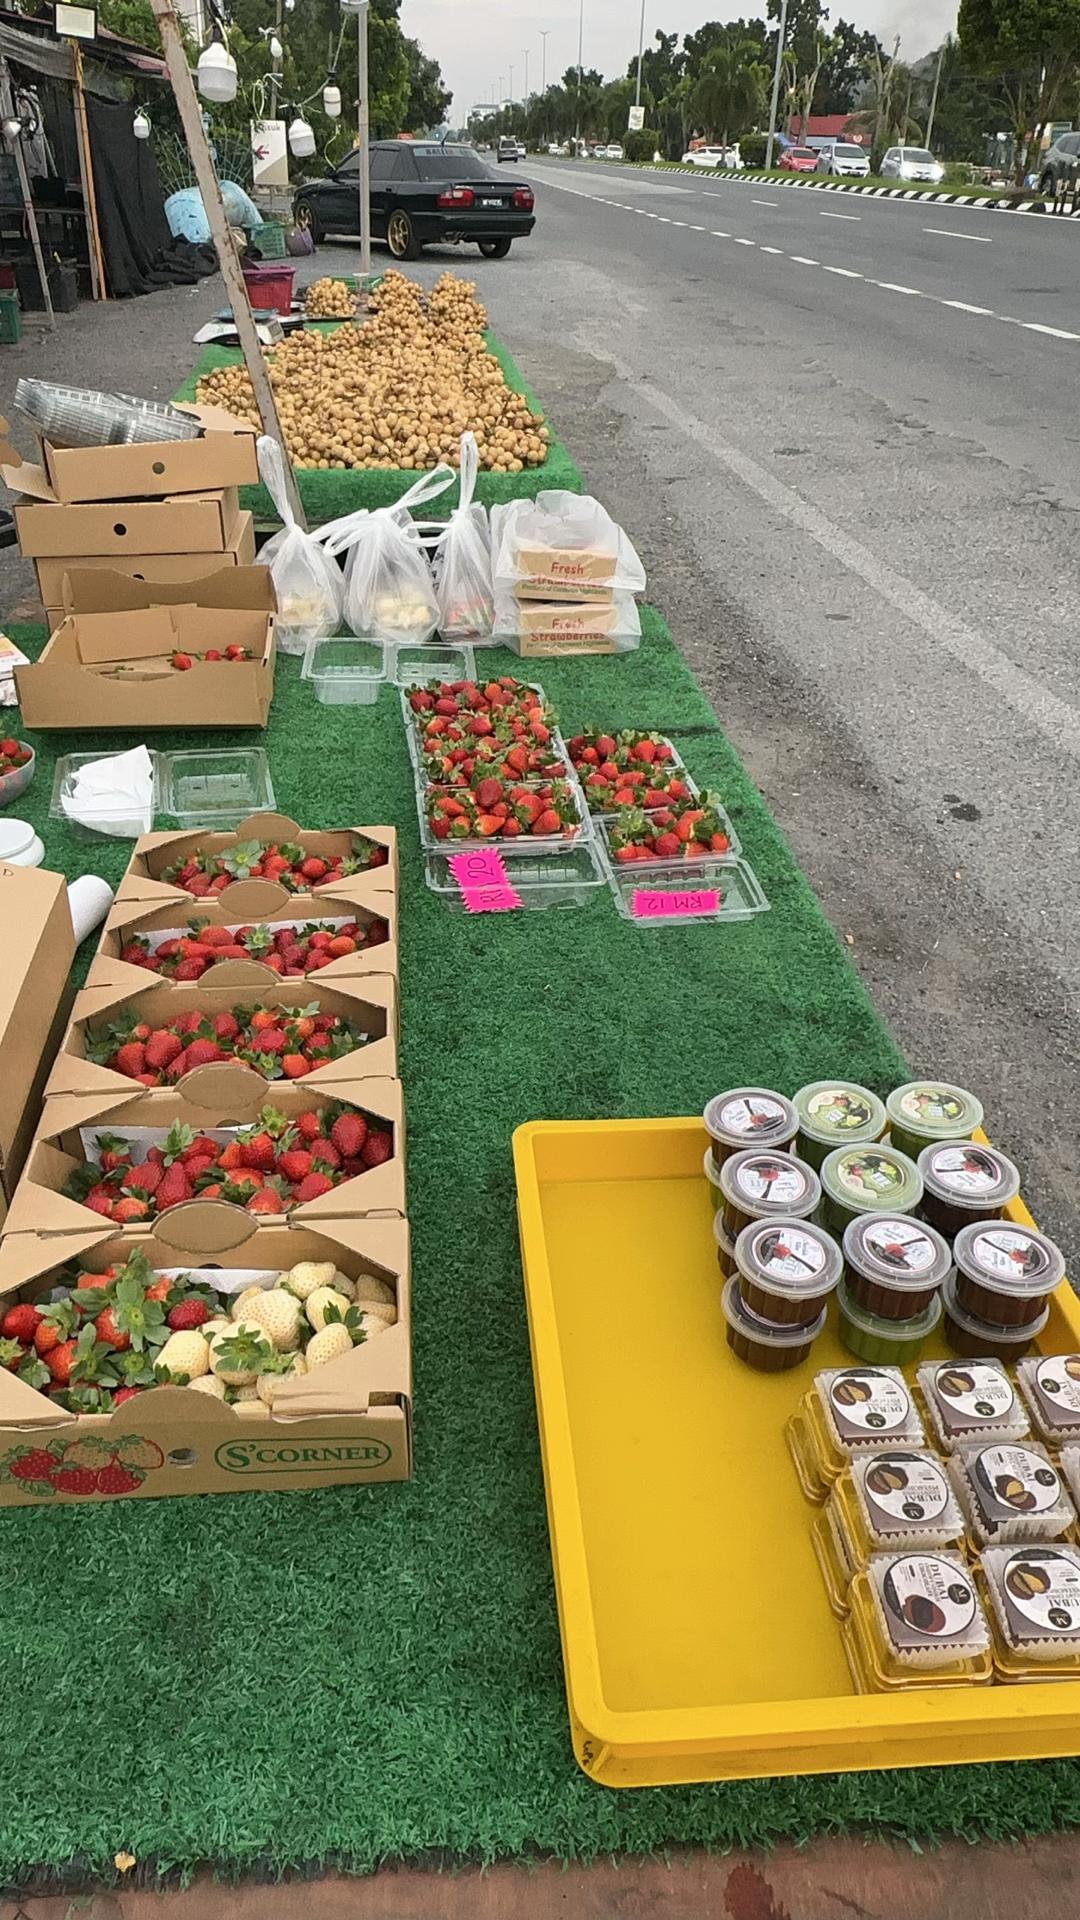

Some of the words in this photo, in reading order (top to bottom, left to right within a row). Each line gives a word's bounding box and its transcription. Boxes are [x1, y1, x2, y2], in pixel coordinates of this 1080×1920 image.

[550, 561, 584, 575] Fresh
[530, 632, 605, 642] Strawberries
[467, 857, 494, 878] 20
[642, 897, 664, 910] 12
[674, 895, 702, 909] RM
[975, 1392, 1009, 1401] DUBAI
[866, 1405, 902, 1414] DUBAI
[226, 1444, 383, 1468] S'CORNER
[1017, 1451, 1036, 1482] DUBAI
[903, 1494, 942, 1503] DUBAI
[918, 1562, 933, 1598] CHOCOLATE
[930, 1563, 949, 1601] DUBAI
[1048, 1599, 1080, 1607] UBAI
